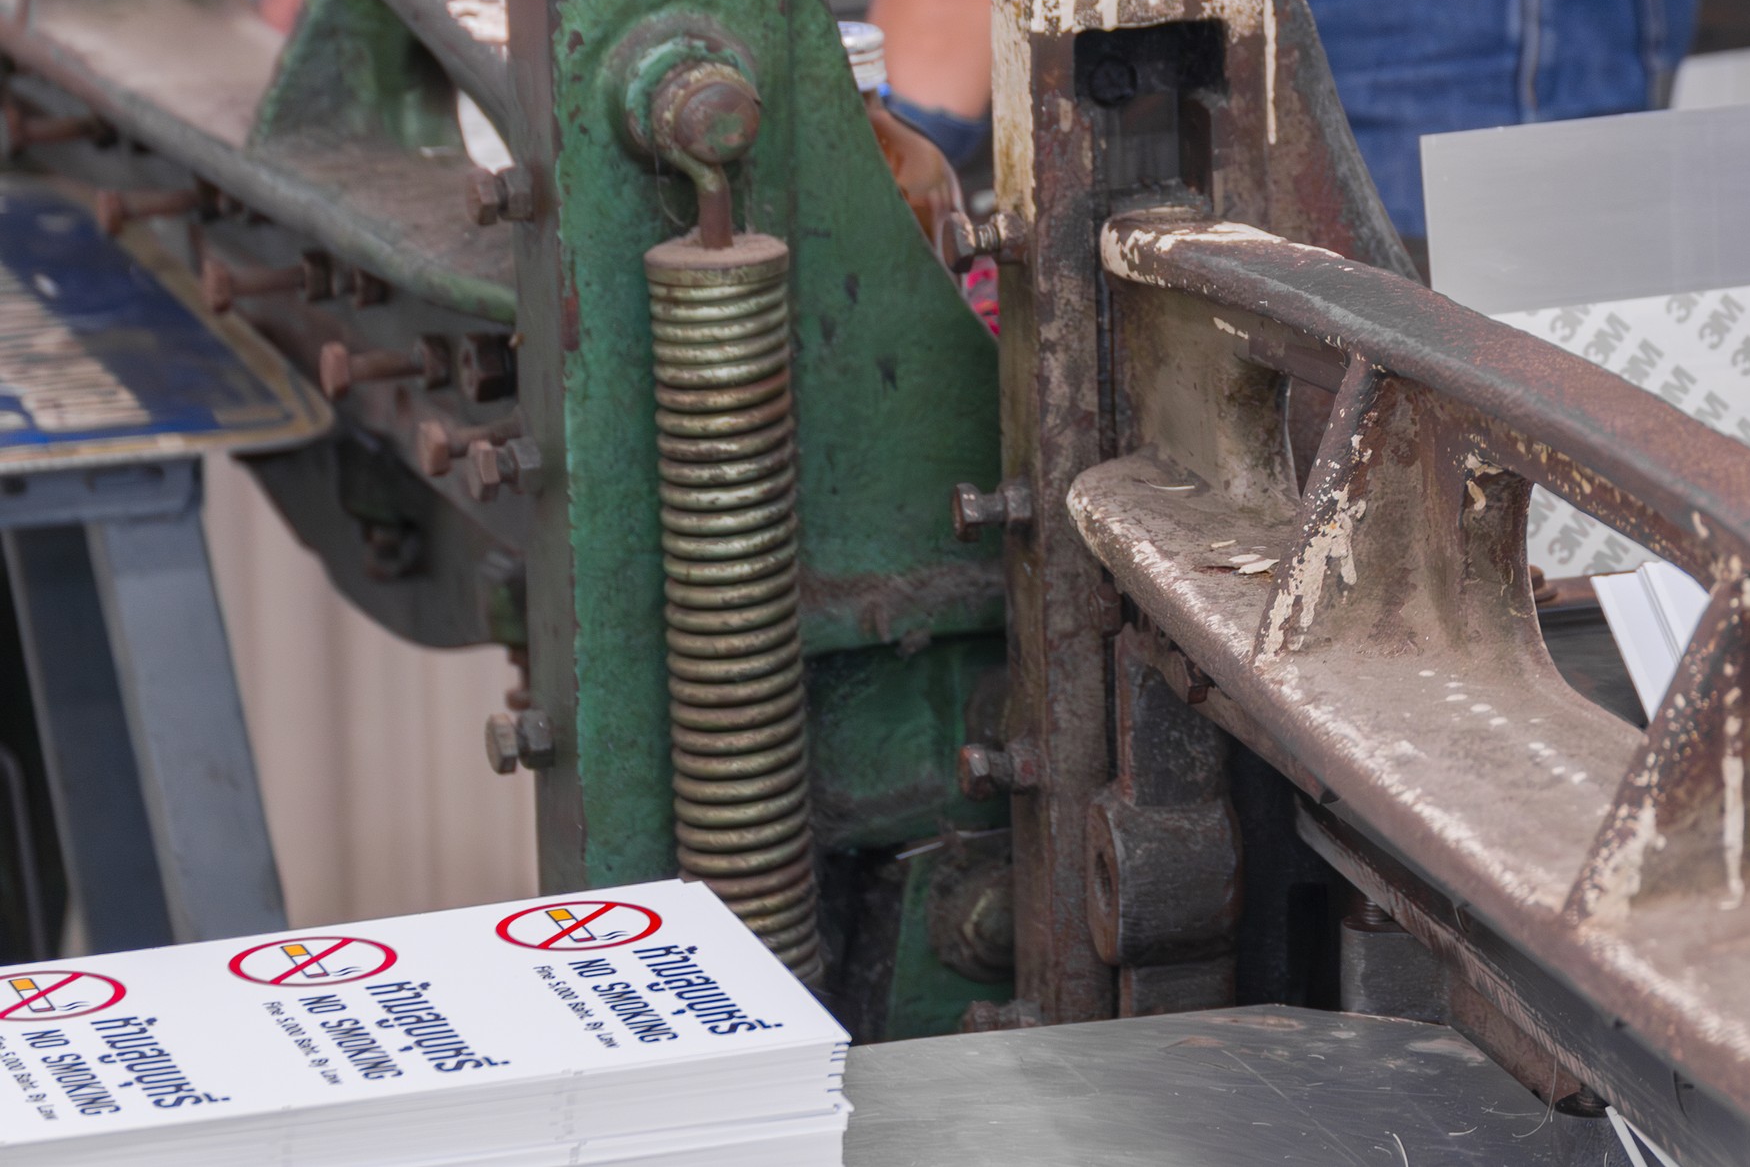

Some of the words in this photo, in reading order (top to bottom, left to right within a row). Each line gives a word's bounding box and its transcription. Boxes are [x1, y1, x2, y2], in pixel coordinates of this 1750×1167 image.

[1699, 293, 1746, 350] 3M
[1547, 510, 1597, 565] 3M
[567, 957, 618, 978] NO
[632, 944, 784, 1036] ห้ามสูบบุหรี่
[298, 994, 348, 1014] NO
[364, 981, 512, 1073] ห้ามสูบบุหรี่
[592, 981, 679, 1044] SMOKING
[21, 1028, 71, 1049] NO
[90, 1016, 232, 1109] ห้ามสูบบุหรี่
[319, 1018, 404, 1080] SMOKING
[41, 1053, 122, 1116] SMOKING
